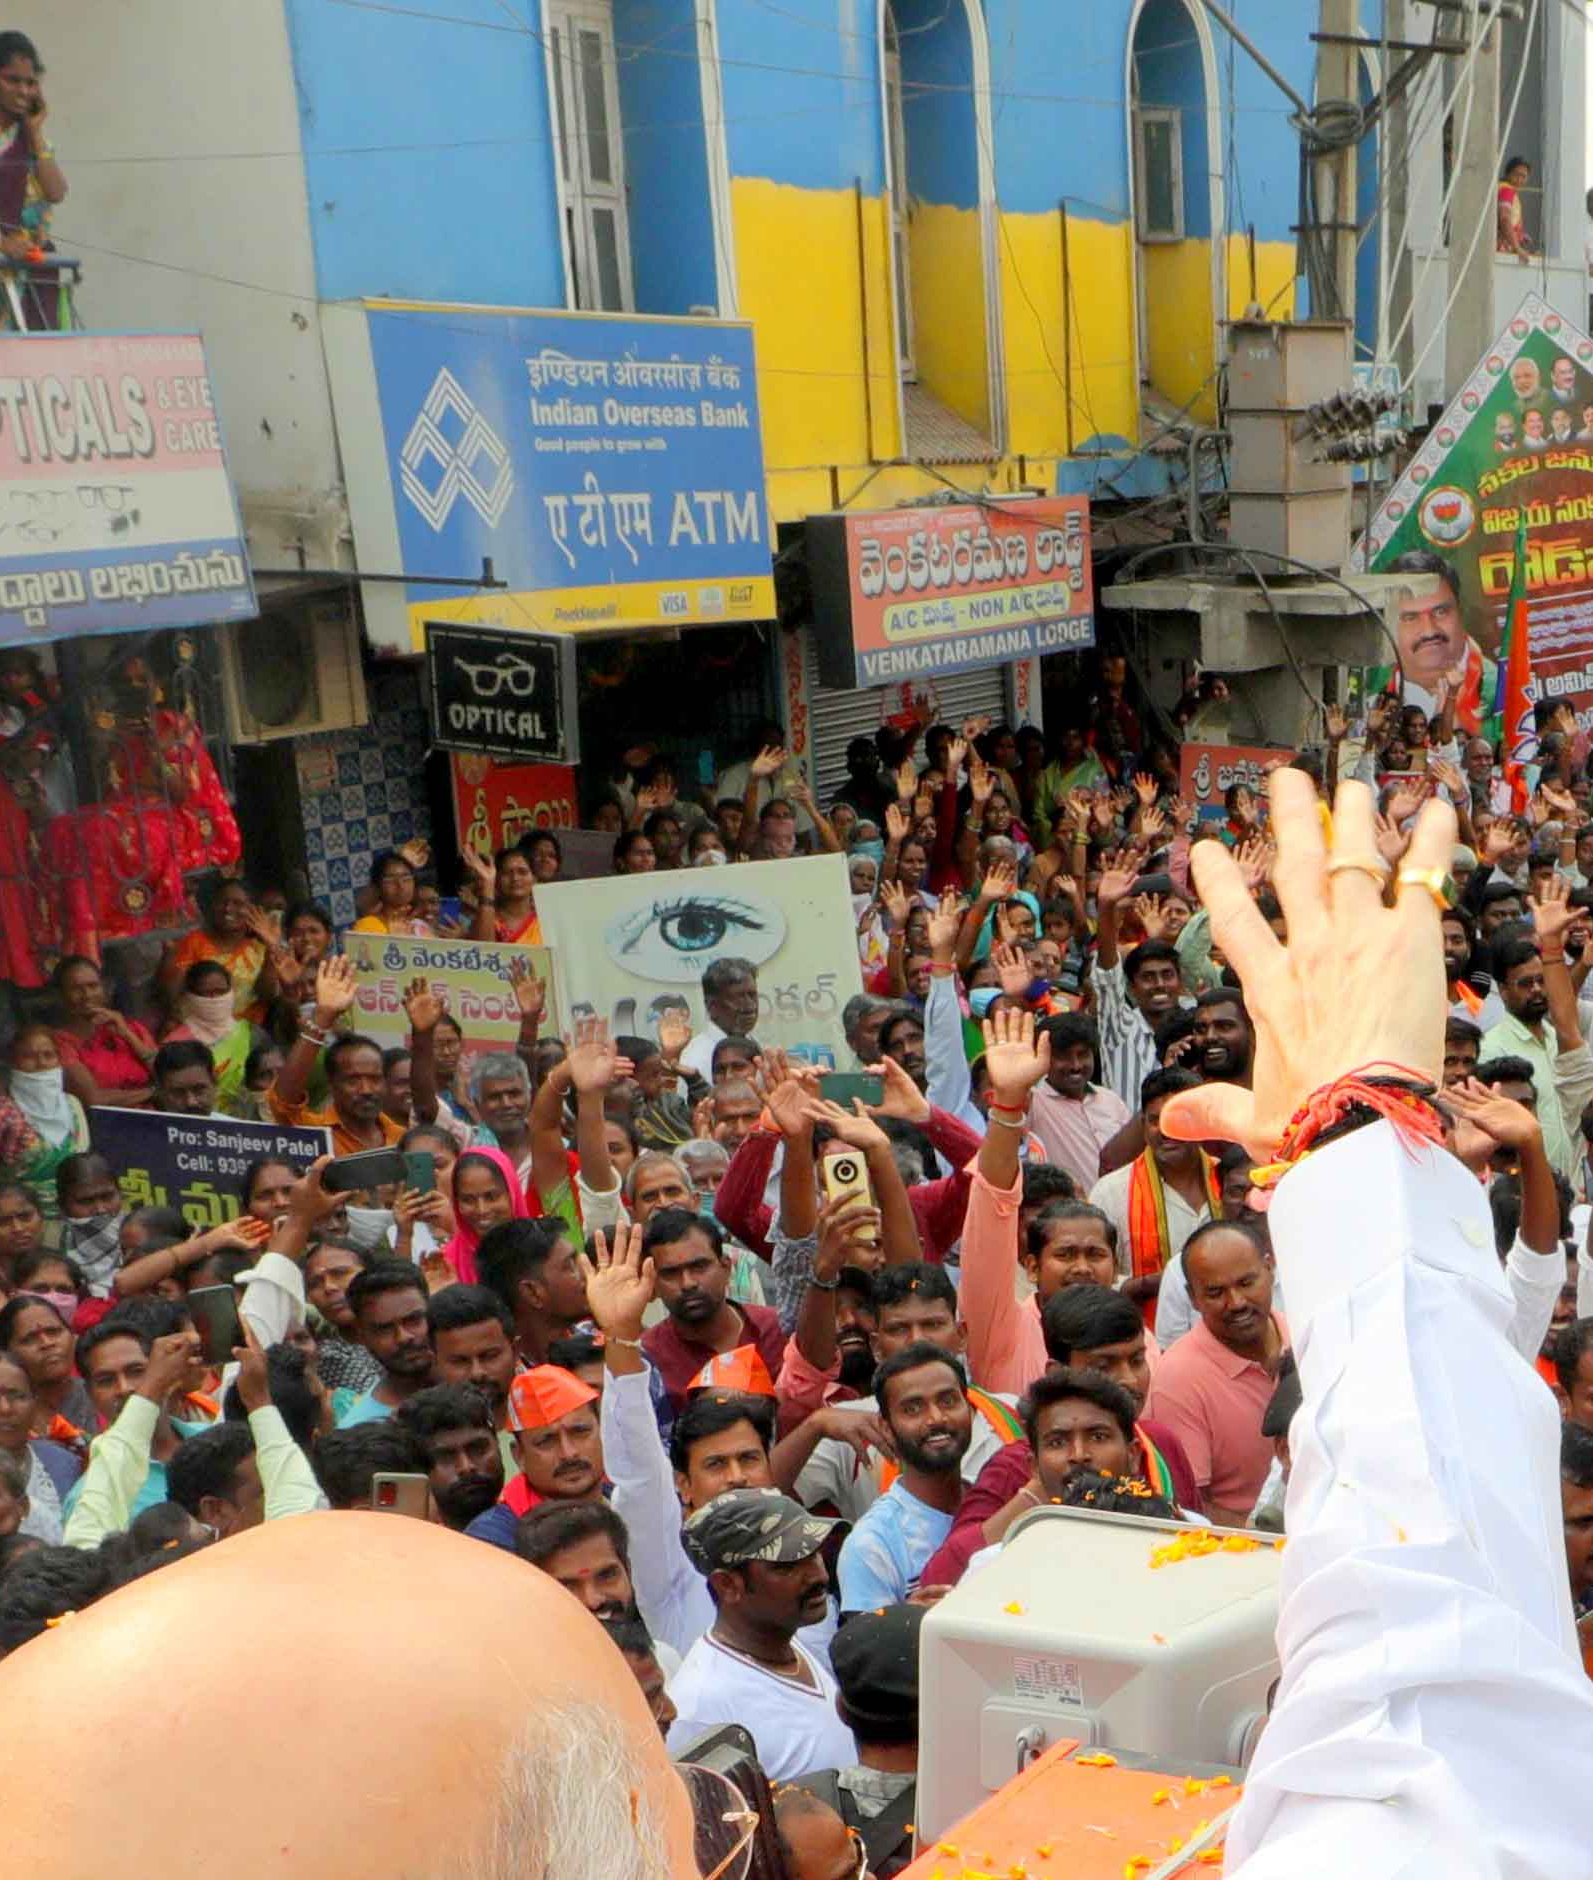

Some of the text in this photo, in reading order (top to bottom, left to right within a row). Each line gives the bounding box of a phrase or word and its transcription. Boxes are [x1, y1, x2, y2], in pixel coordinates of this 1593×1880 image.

[525, 348, 609, 393] इण्डियन
[705, 355, 742, 391] बैंक
[153, 376, 213, 411] & EYE
[530, 397, 750, 429] Indian Overseas Bank
[164, 420, 222, 454] CARE
[668, 490, 760, 546] ATM
[859, 525, 1029, 599] వెంకటరమణ
[662, 591, 688, 613] VISA
[890, 611, 919, 631] A/C
[969, 597, 1004, 619] NON
[1009, 592, 1035, 614] A/C
[863, 618, 1091, 677] VENKATARAMANA LODGE
[448, 703, 547, 741] OPTICAL
[383, 942, 407, 972] శ్రీ
[167, 1127, 319, 1157] Pro: Sanjeev Patel
[176, 1153, 214, 1172] Cell:
